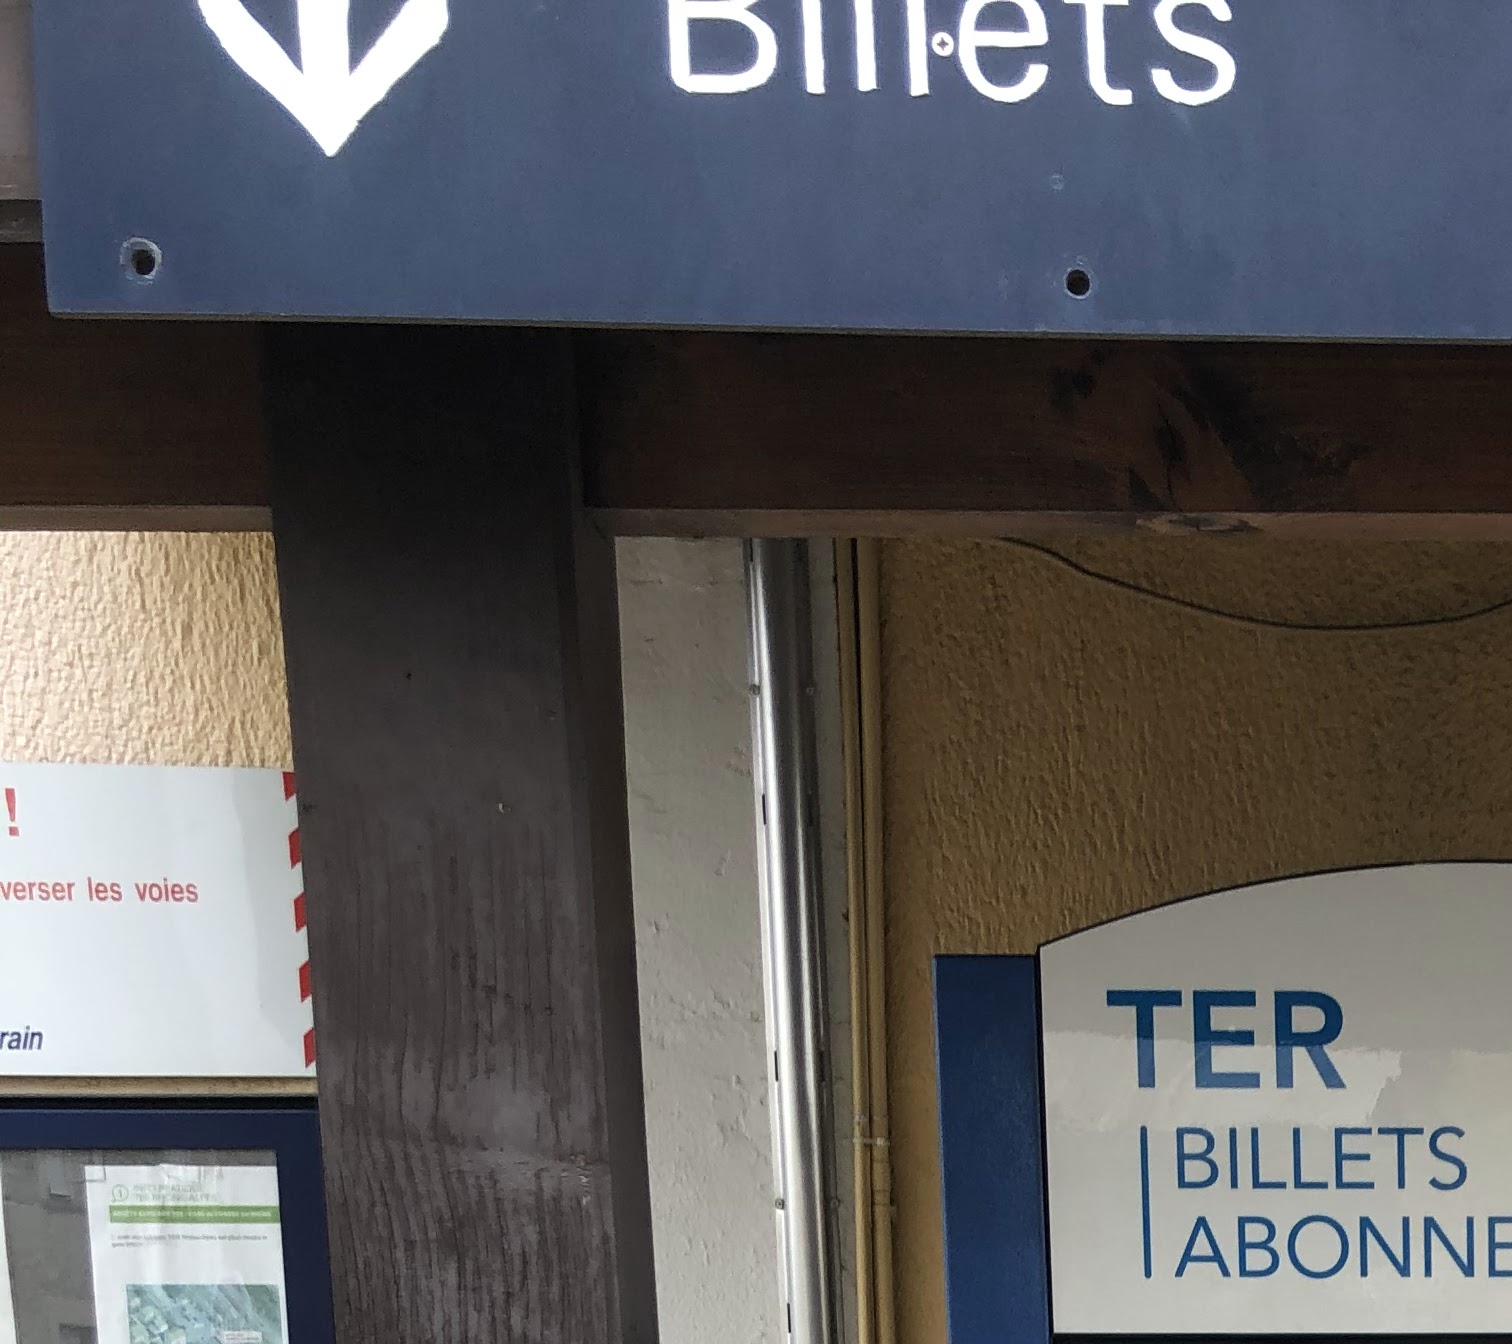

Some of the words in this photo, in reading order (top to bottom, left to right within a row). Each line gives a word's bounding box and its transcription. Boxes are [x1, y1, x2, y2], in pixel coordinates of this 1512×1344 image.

[668, 0, 1236, 106] Billets
[87, 876, 123, 903] les
[135, 877, 199, 904] voies
[1106, 988, 1347, 1090] TER
[1176, 1125, 1468, 1191] BILLETS
